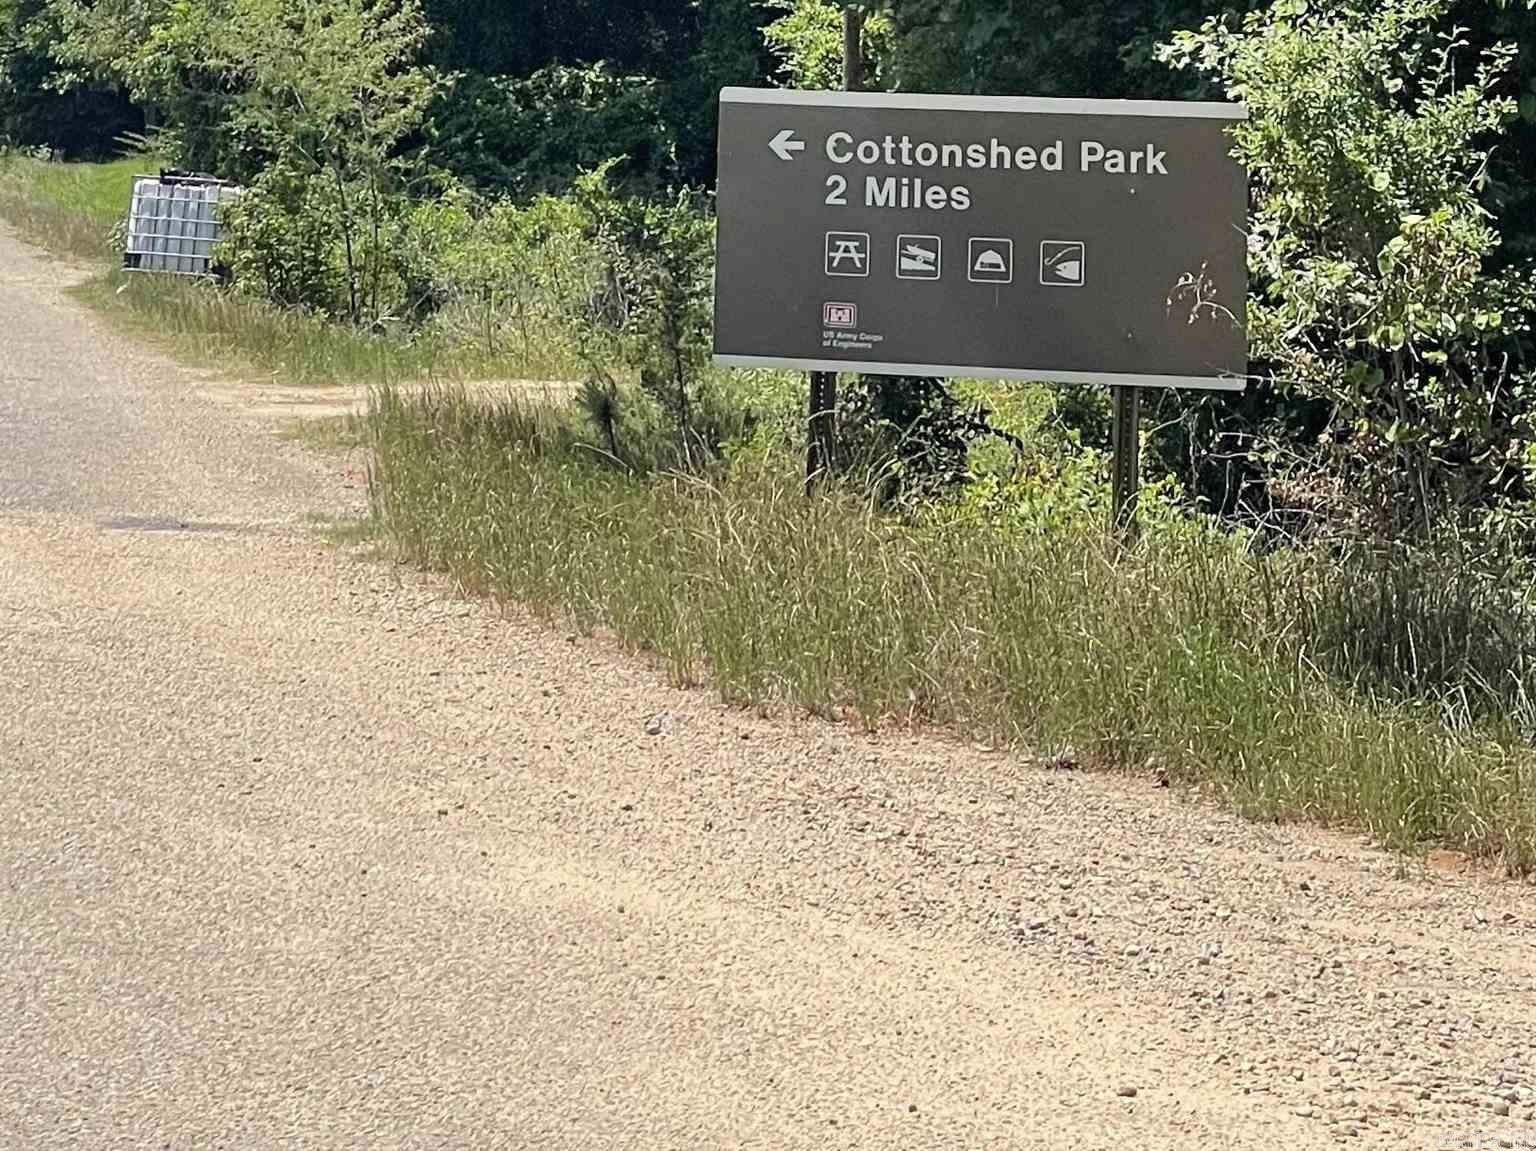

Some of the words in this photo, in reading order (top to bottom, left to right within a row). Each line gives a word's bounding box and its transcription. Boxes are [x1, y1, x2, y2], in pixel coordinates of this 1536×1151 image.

[825, 131, 1063, 171] Cottonshed
[1080, 141, 1170, 175] Park
[824, 174, 847, 205] 2
[865, 176, 971, 210] Miles
[832, 339, 873, 349] Engineers
[836, 331, 857, 341] Army
[859, 332, 884, 342] Corps
